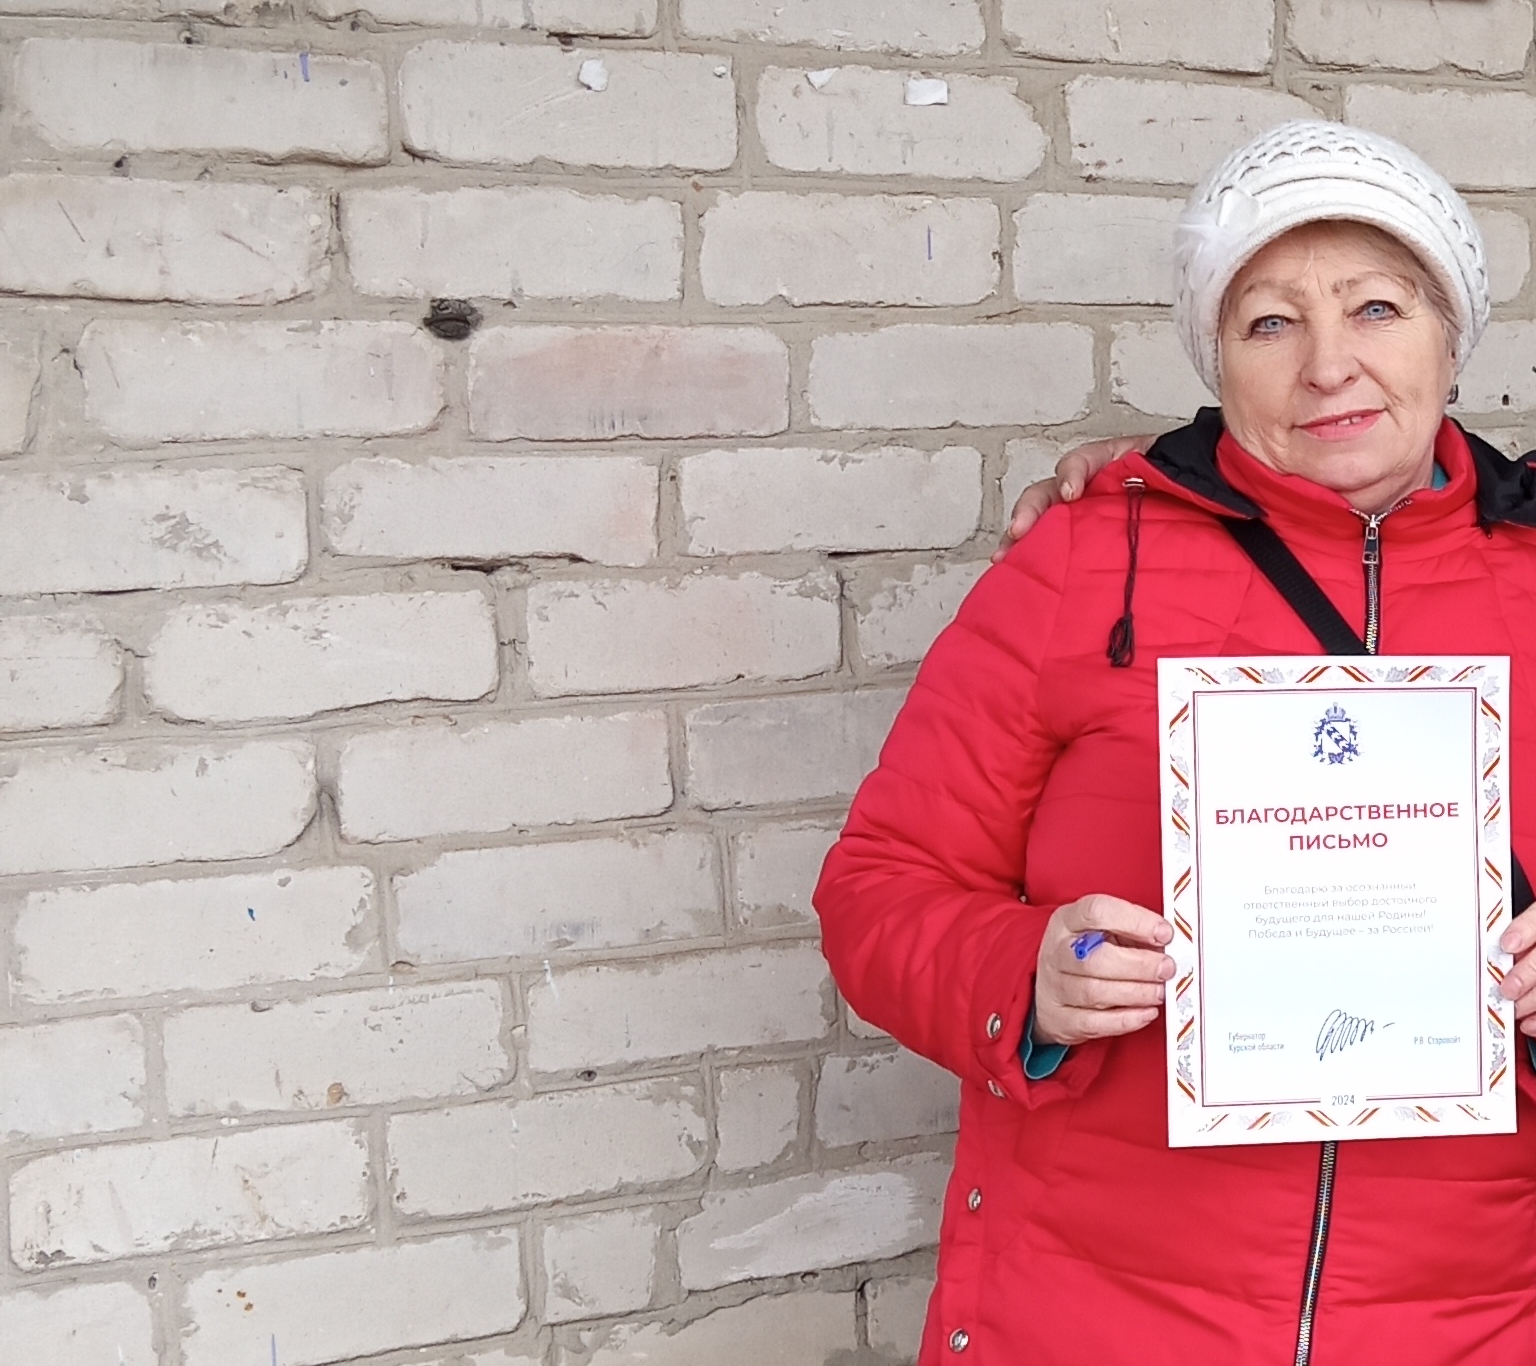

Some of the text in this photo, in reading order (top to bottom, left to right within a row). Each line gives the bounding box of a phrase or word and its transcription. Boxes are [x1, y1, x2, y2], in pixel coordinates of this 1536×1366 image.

[1215, 802, 1459, 825] БЛАГОДАРСТВЕННОЕ
[1289, 833, 1388, 851] ПИСЬМО
[1264, 885, 1328, 895] Благодарю
[1331, 885, 1343, 893] за
[1332, 897, 1369, 907] выбор
[1313, 915, 1334, 923] для
[1248, 929, 1292, 939] Победа
[1367, 927, 1379, 935] за
[1331, 1095, 1355, 1106] 2024
